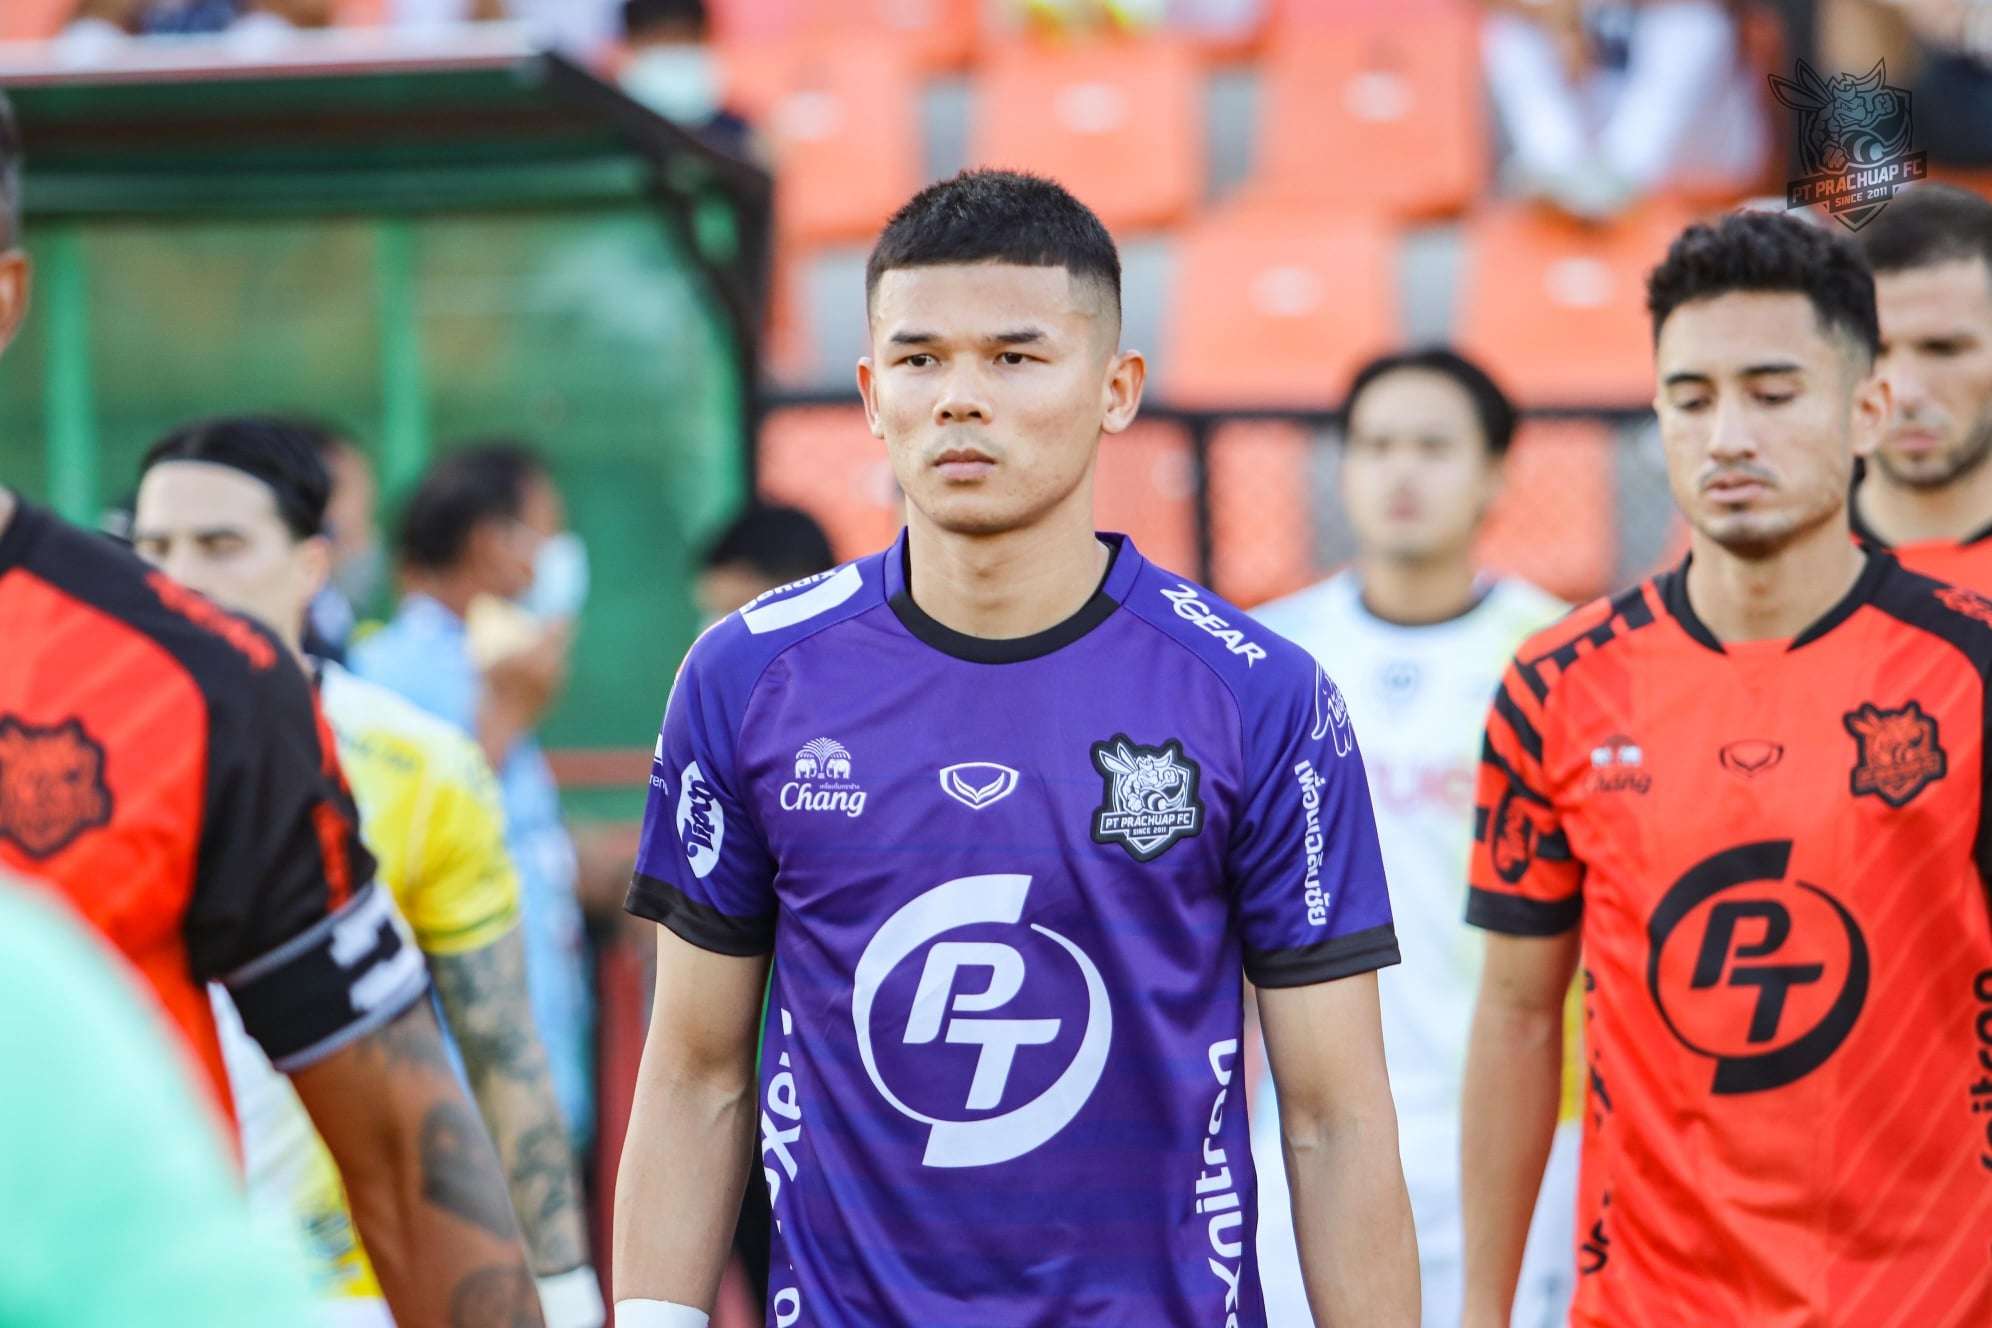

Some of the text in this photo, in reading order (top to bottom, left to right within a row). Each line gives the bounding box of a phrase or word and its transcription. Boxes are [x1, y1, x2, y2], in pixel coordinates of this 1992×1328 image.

[1160, 584, 1266, 667] 2GEAR
[780, 782, 867, 818] Chang
[1105, 812, 1190, 829] PT PRACHUAP FC
[1132, 826, 1167, 835] SINCE 2011
[1690, 899, 1824, 1044] PT
[902, 941, 1062, 1110] PT
